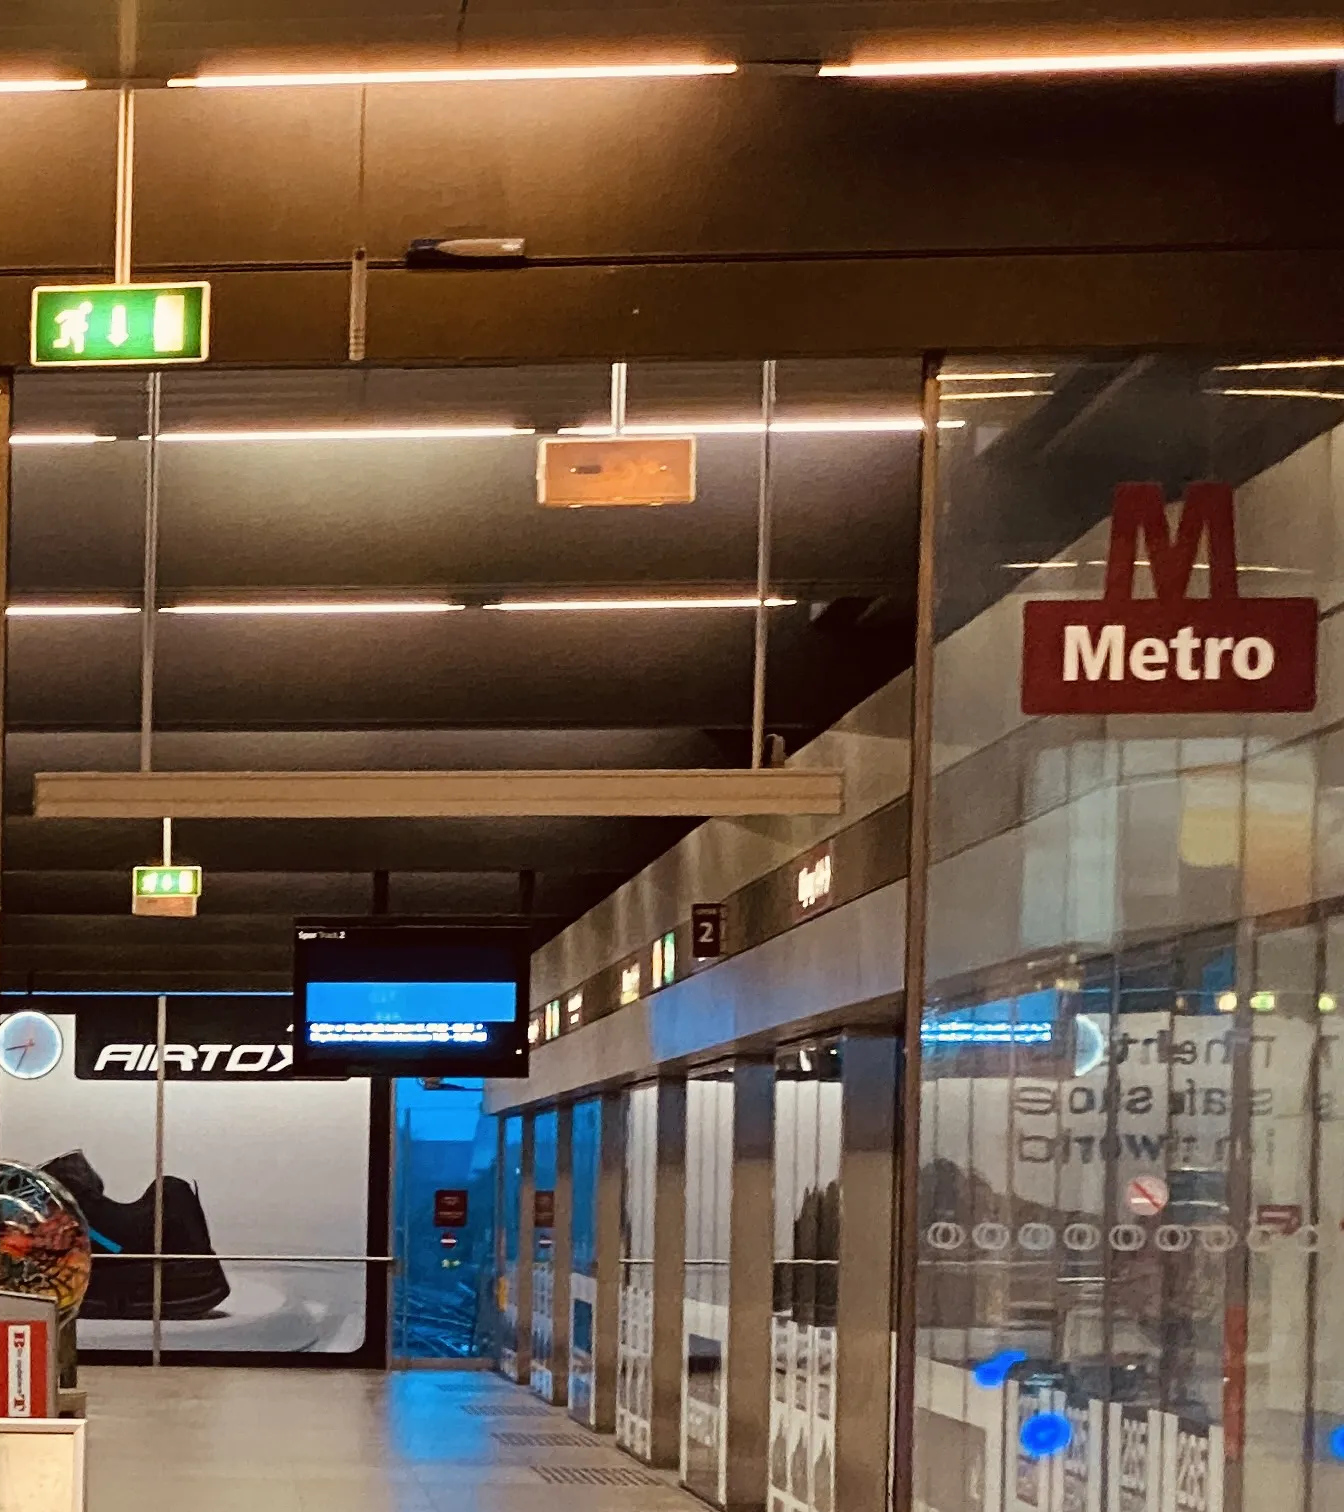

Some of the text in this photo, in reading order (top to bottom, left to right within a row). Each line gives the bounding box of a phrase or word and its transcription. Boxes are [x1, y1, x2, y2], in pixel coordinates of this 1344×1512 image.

[1105, 481, 1239, 600] M
[1063, 625, 1274, 681] Metro
[699, 922, 713, 943] 2
